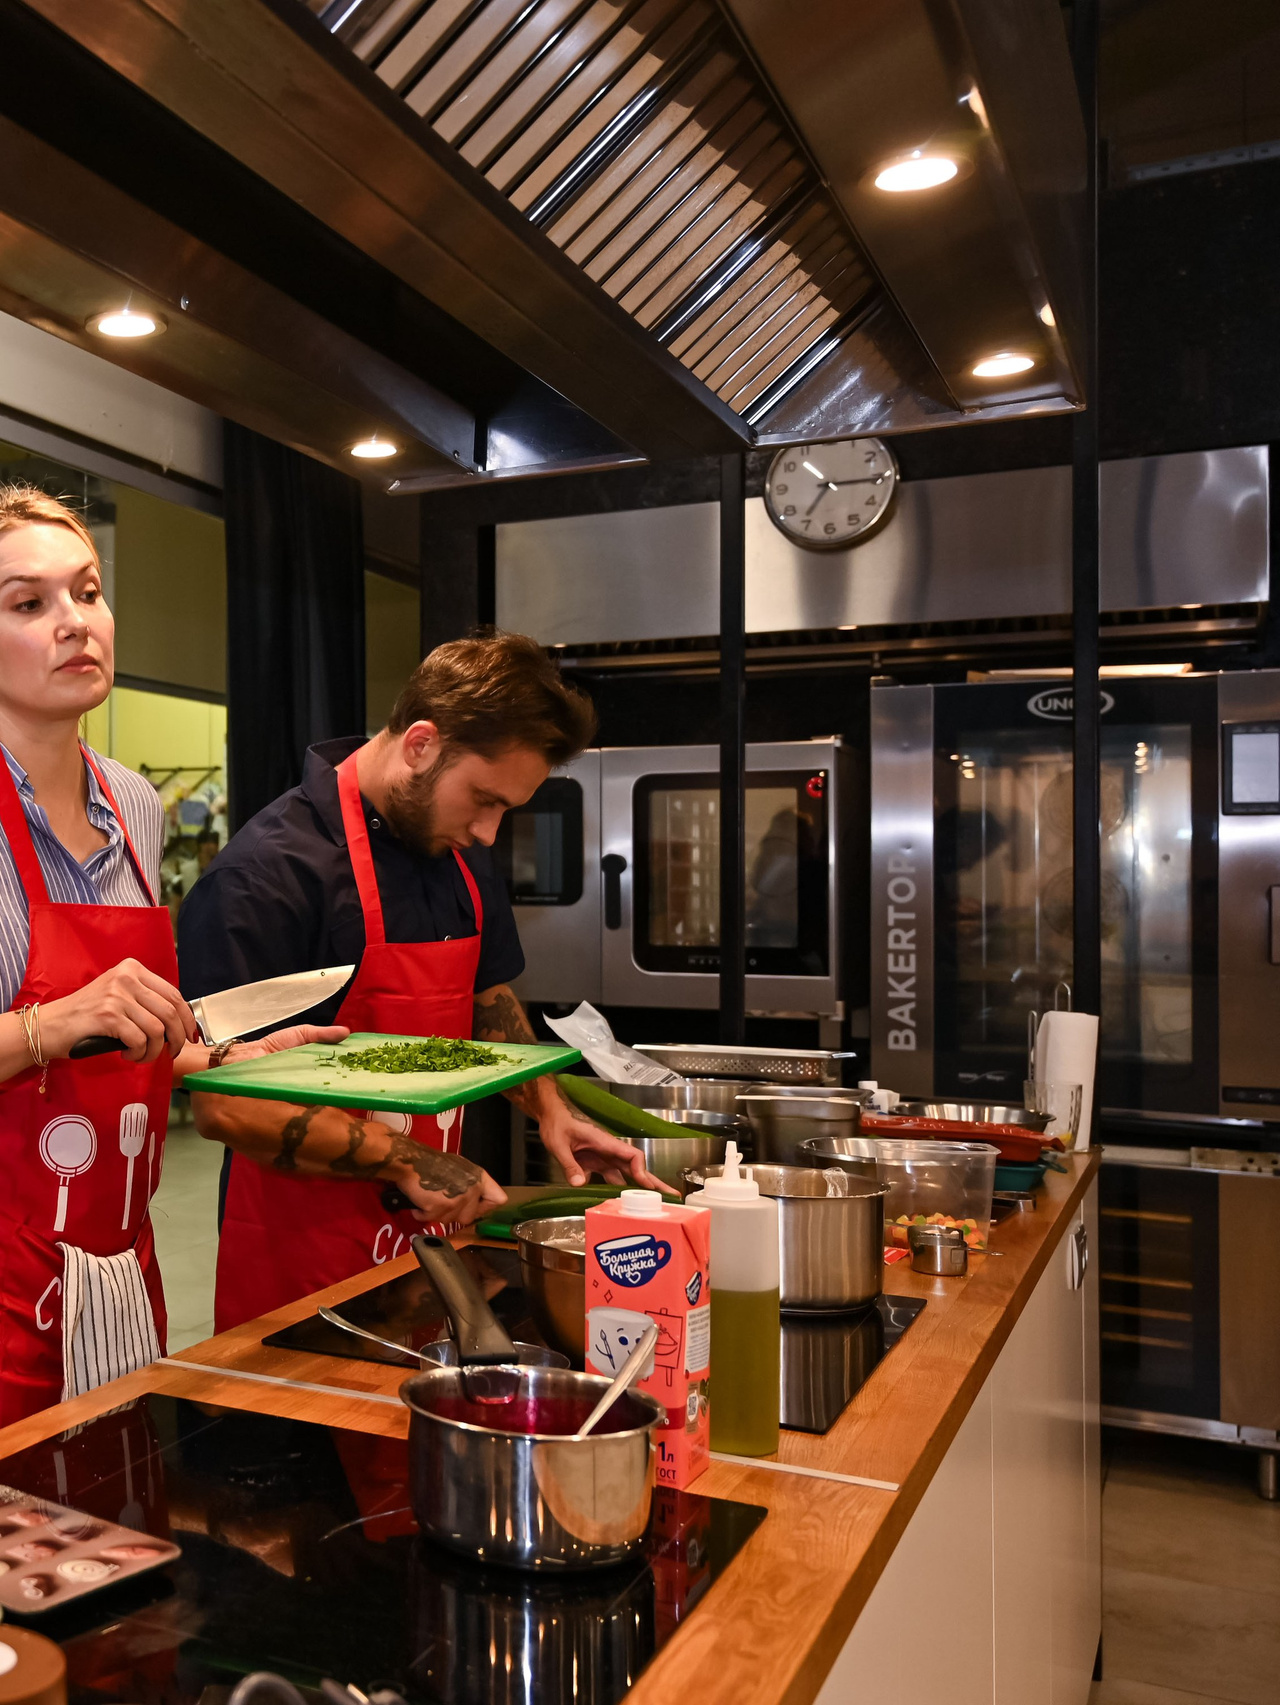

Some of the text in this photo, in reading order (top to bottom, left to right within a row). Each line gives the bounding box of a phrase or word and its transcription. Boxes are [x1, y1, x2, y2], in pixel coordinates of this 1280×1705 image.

[864, 451, 876, 463] 2
[783, 461, 797, 473] 10
[776, 484, 789, 496] 9
[864, 495, 876, 506] 4
[783, 505, 797, 517] 8
[847, 513, 861, 525] 5
[800, 519, 812, 532] 7
[823, 522, 837, 535] 6
[887, 854, 917, 1051] BAKERTOP
[599, 1247, 655, 1266] Большая
[609, 1258, 657, 1280] Кружка
